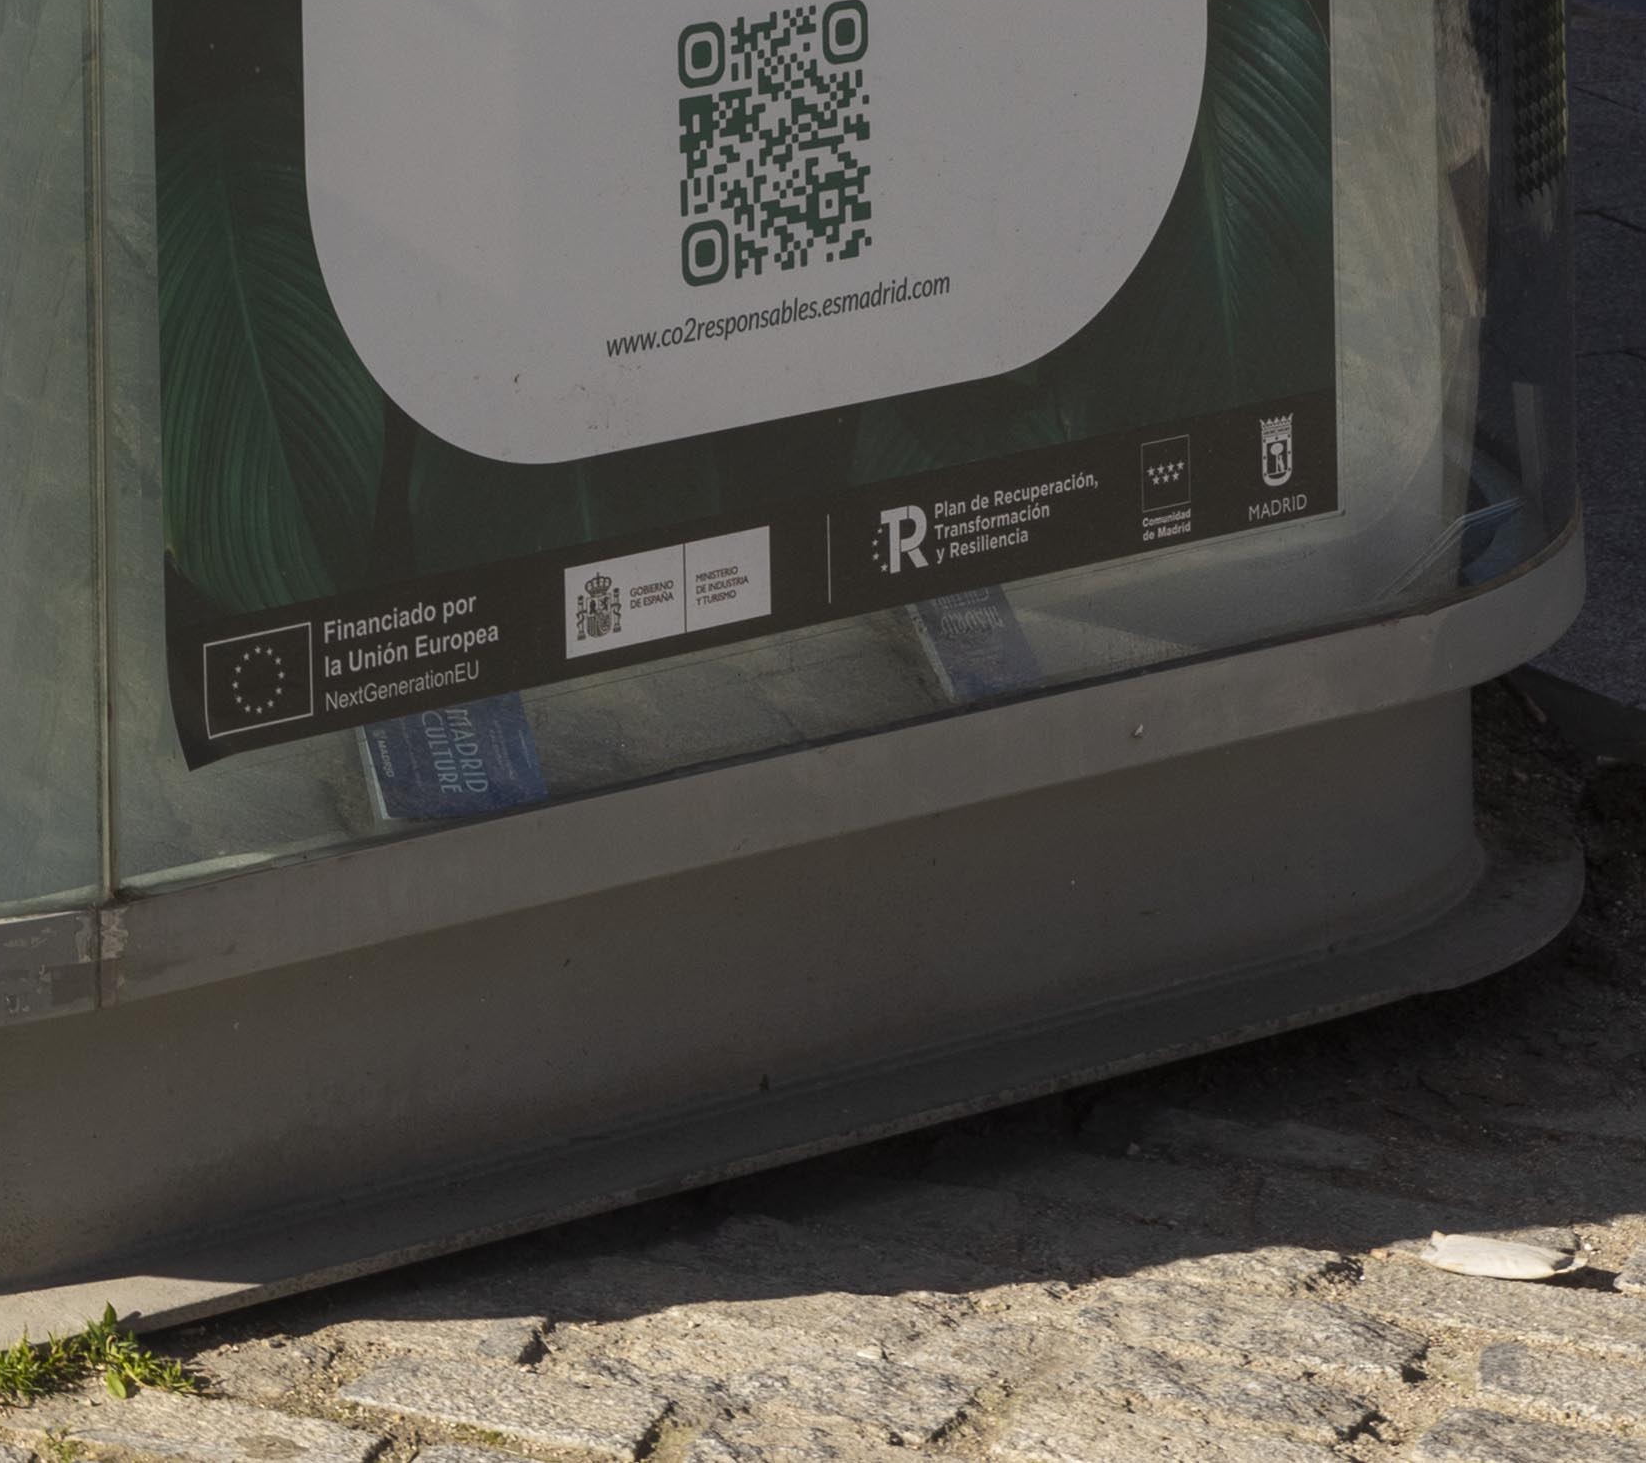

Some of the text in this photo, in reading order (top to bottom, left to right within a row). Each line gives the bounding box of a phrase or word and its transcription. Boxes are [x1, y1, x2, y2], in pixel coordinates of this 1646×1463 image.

[607, 276, 950, 357] www.co2responsables.esmadrid.com
[935, 472, 1098, 518] Plan de Recuperación,
[1249, 494, 1309, 521] MADRID
[934, 503, 1049, 539] Transformación
[1142, 509, 1191, 528] Comunidad
[1142, 521, 1191, 541] de Madrid
[936, 528, 1028, 564] y Resiliencia
[630, 580, 674, 597] GOBIERNO
[695, 566, 739, 583] MINISTERIO
[708, 575, 749, 592] INDUSTRIA
[643, 591, 674, 607] ESPAÑA
[324, 596, 476, 643] Financiado por
[325, 626, 498, 677] la Unión Europea
[326, 660, 479, 711] NextGenerationEU
[422, 710, 463, 794] CULTURE
